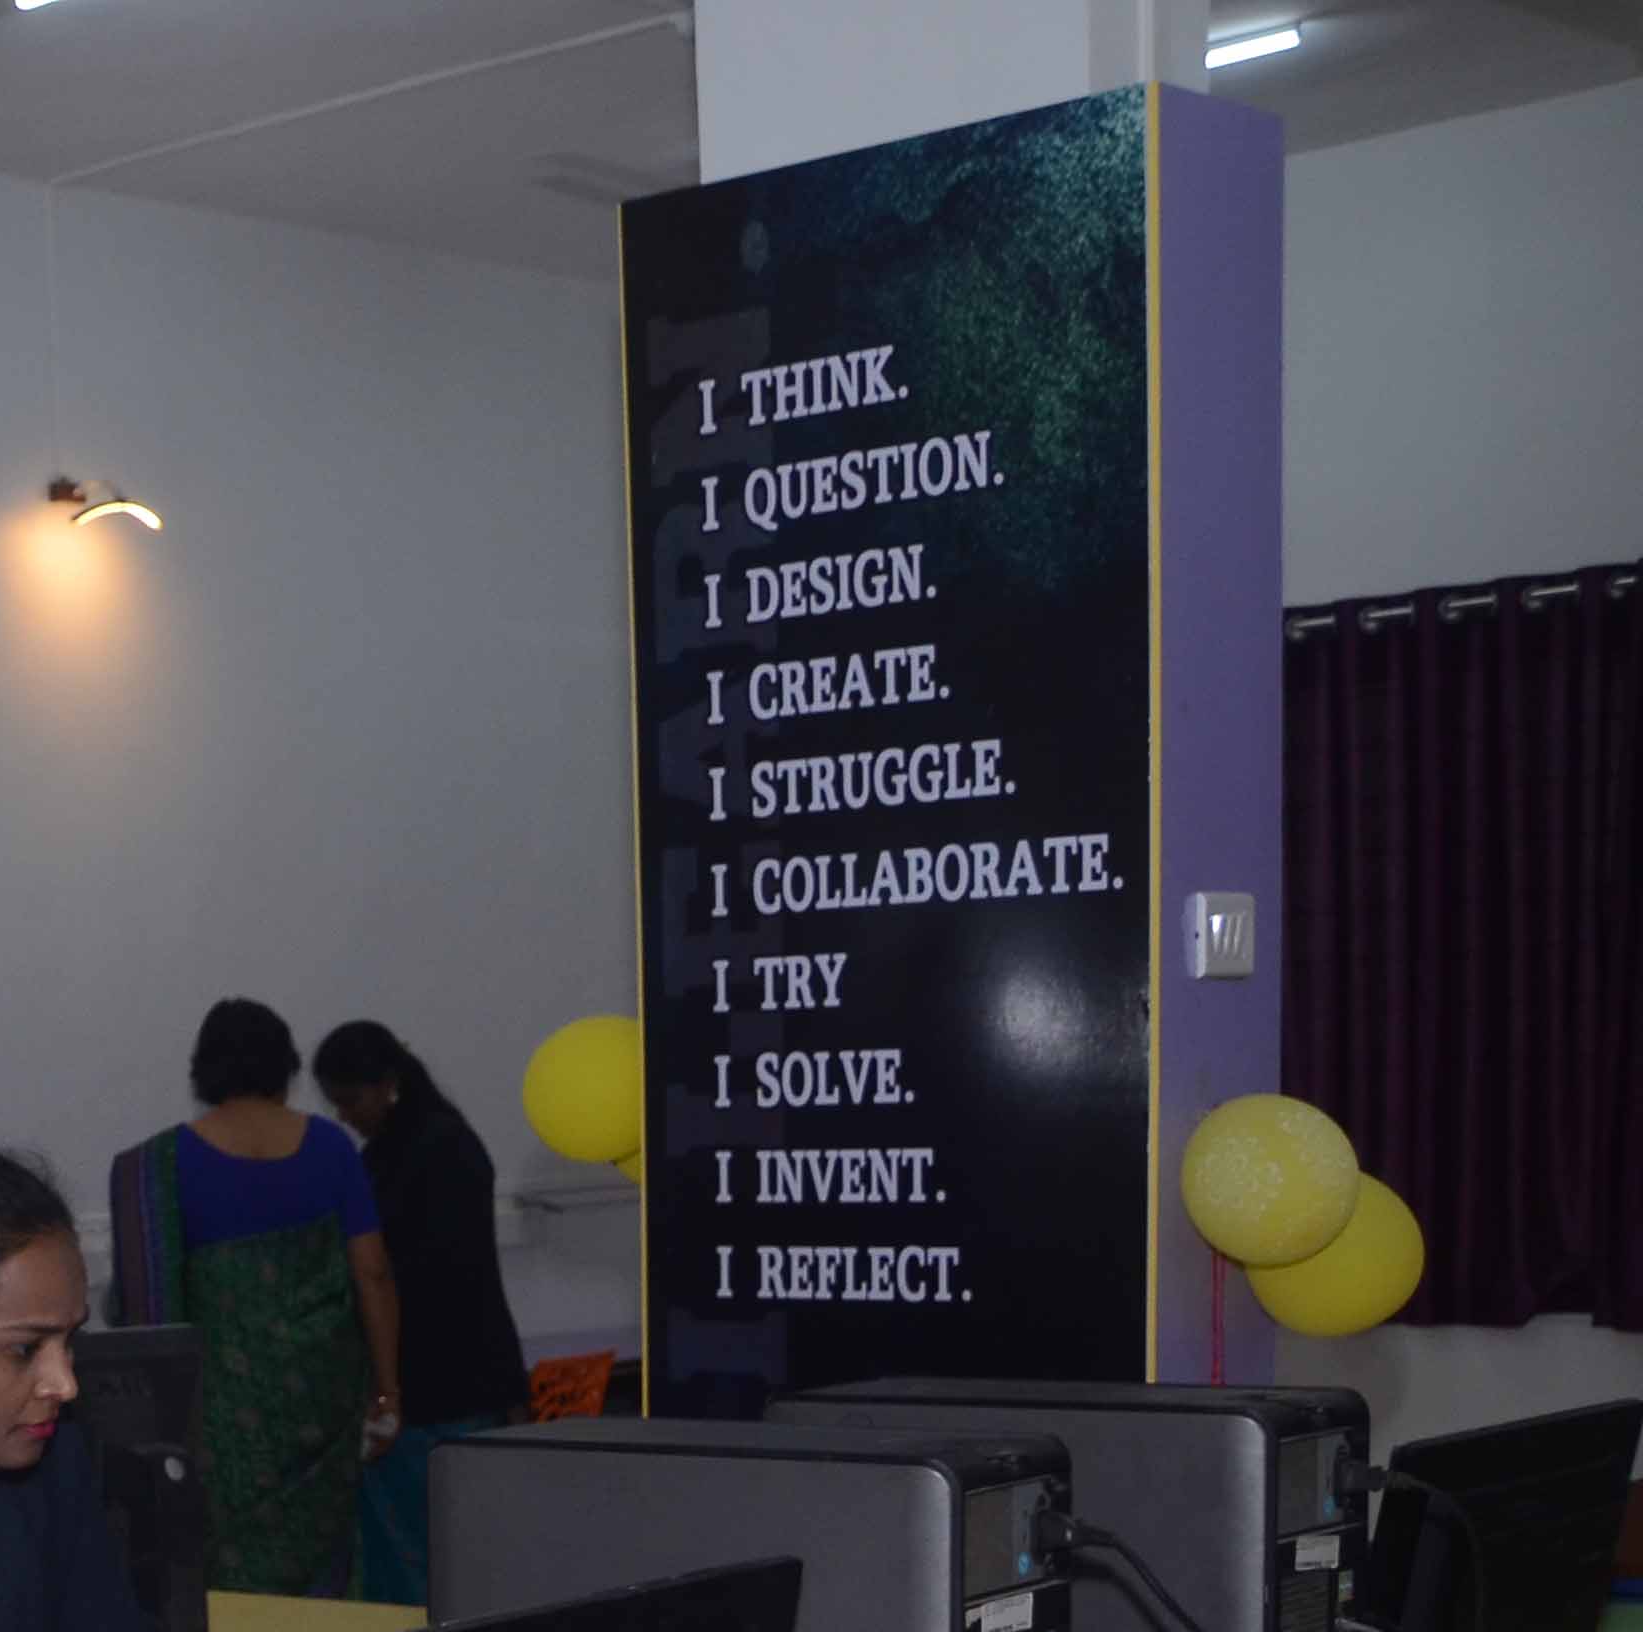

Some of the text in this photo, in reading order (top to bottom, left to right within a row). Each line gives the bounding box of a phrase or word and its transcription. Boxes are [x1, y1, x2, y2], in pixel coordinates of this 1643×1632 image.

[699, 345, 908, 434] I THINK.
[702, 431, 1003, 531] I QUESTION.
[705, 544, 936, 627] I DESIGN.
[707, 645, 949, 724] I CREATE.
[709, 739, 1015, 820] I STRUGGLE.
[712, 834, 1123, 916] I COLLABORATE.
[713, 953, 846, 1011] I TRY
[715, 1049, 914, 1107] I SOLVE.
[716, 1149, 945, 1202] I INVENT.
[718, 1246, 971, 1301] I REFLECT.
